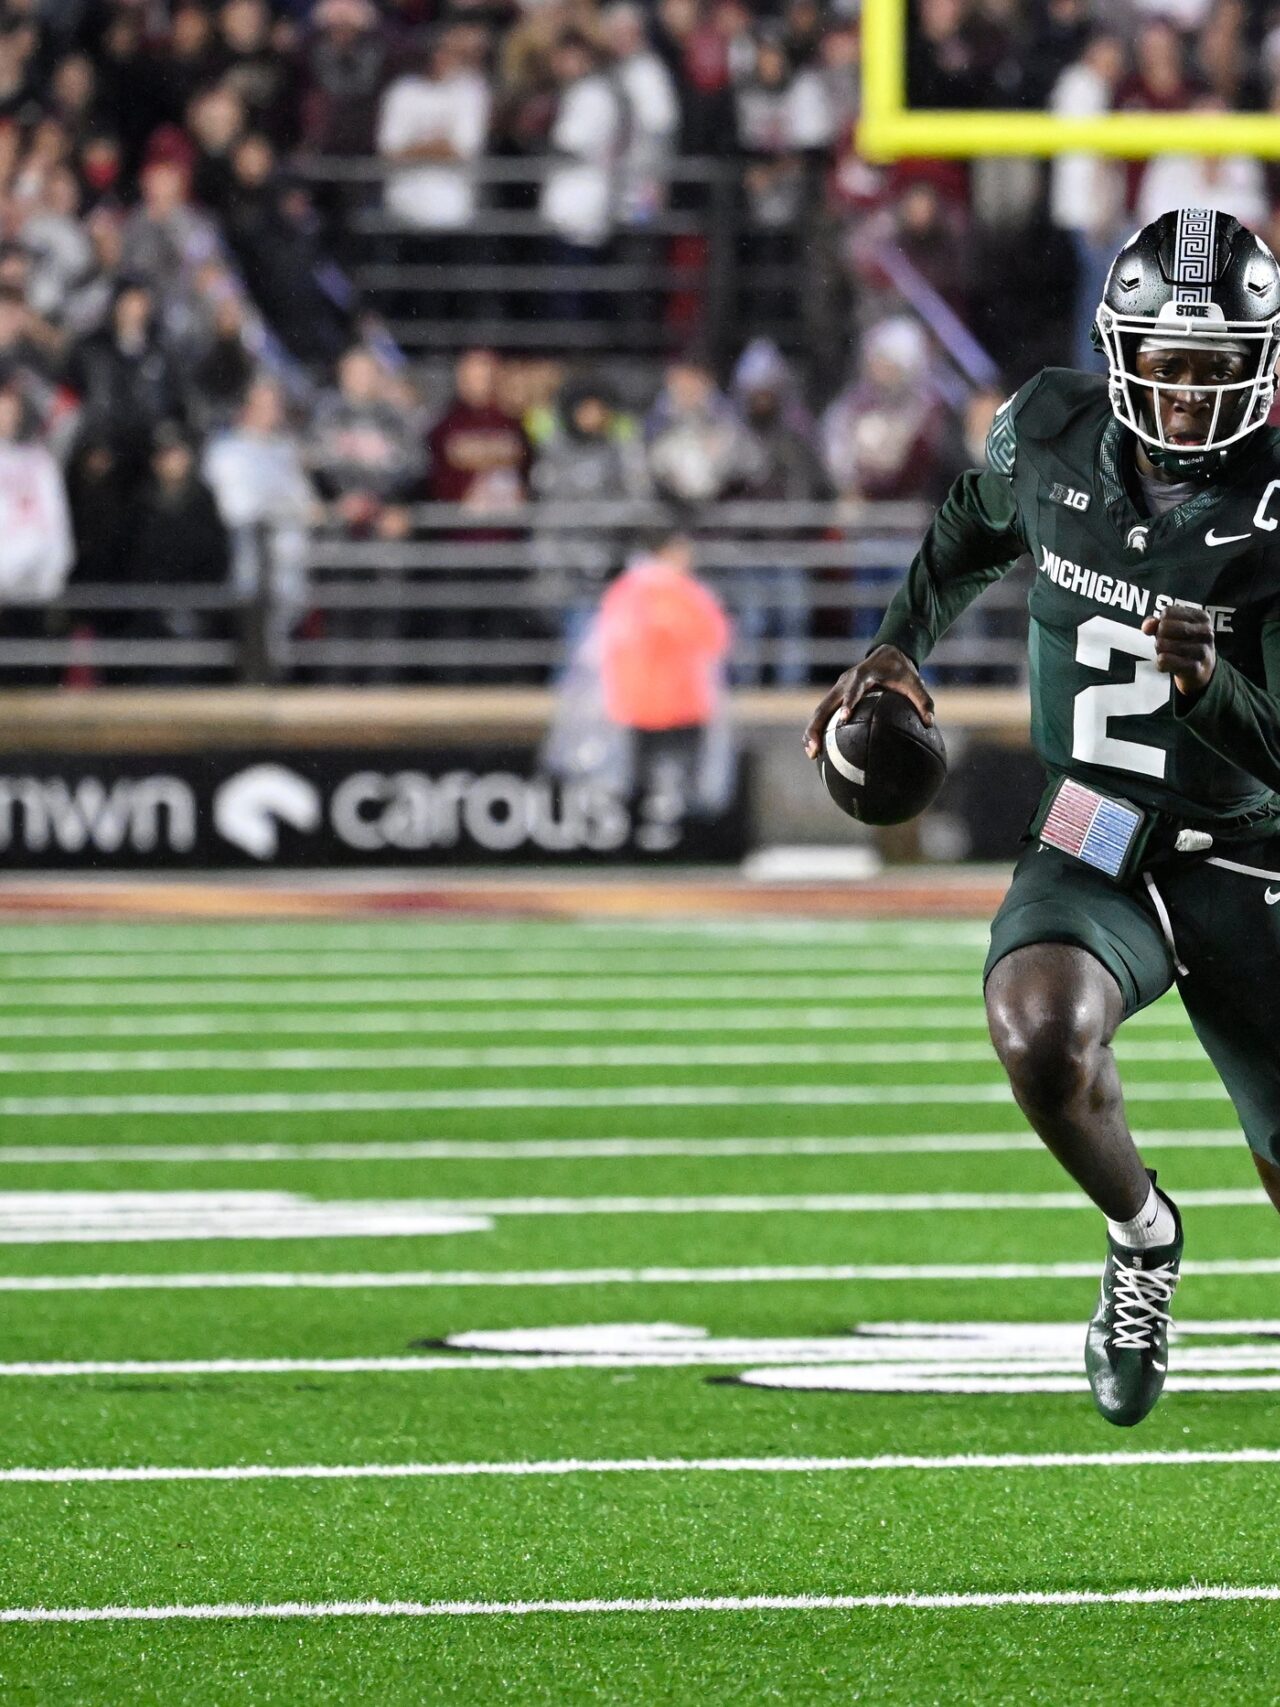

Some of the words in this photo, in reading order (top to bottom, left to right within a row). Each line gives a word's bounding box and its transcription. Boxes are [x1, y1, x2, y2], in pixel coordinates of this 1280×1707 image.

[1176, 304, 1209, 318] STATE
[1178, 455, 1205, 466] Riddell
[1072, 615, 1171, 779] 2
